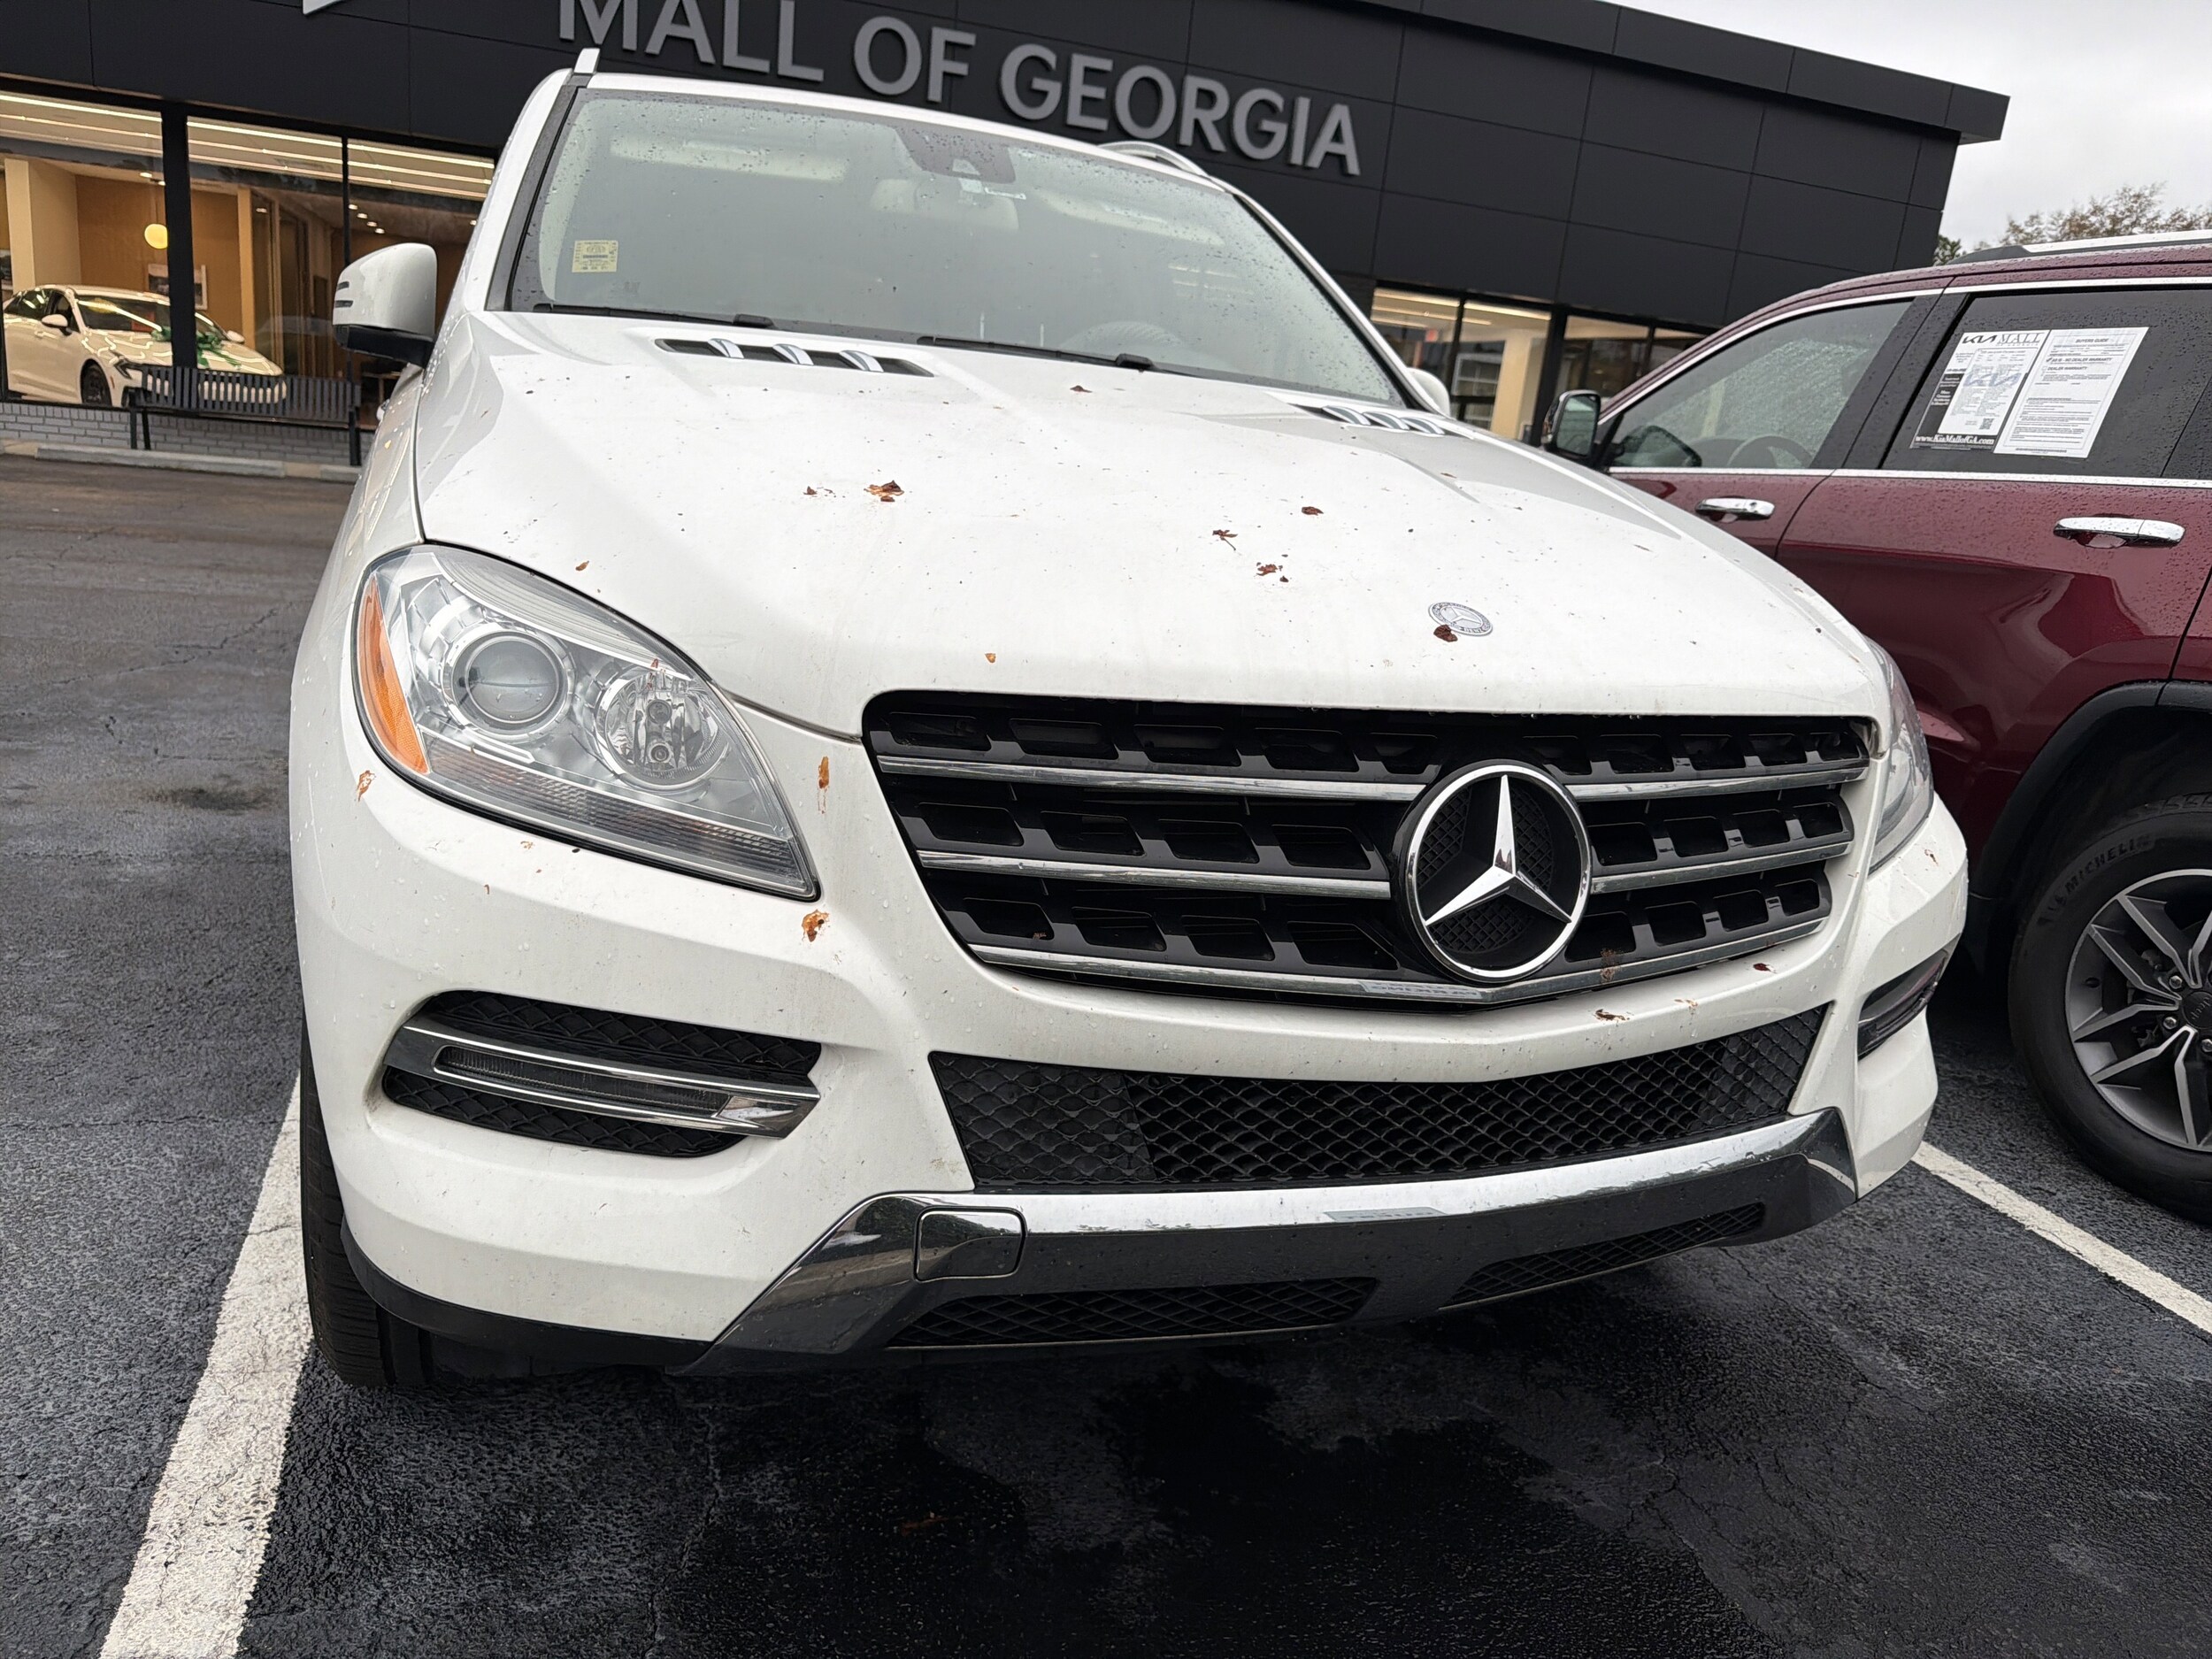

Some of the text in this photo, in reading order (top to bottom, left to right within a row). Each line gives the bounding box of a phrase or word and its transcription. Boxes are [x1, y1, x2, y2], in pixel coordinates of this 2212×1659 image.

[559, 0, 1361, 176] MALL OF GEORGIA
